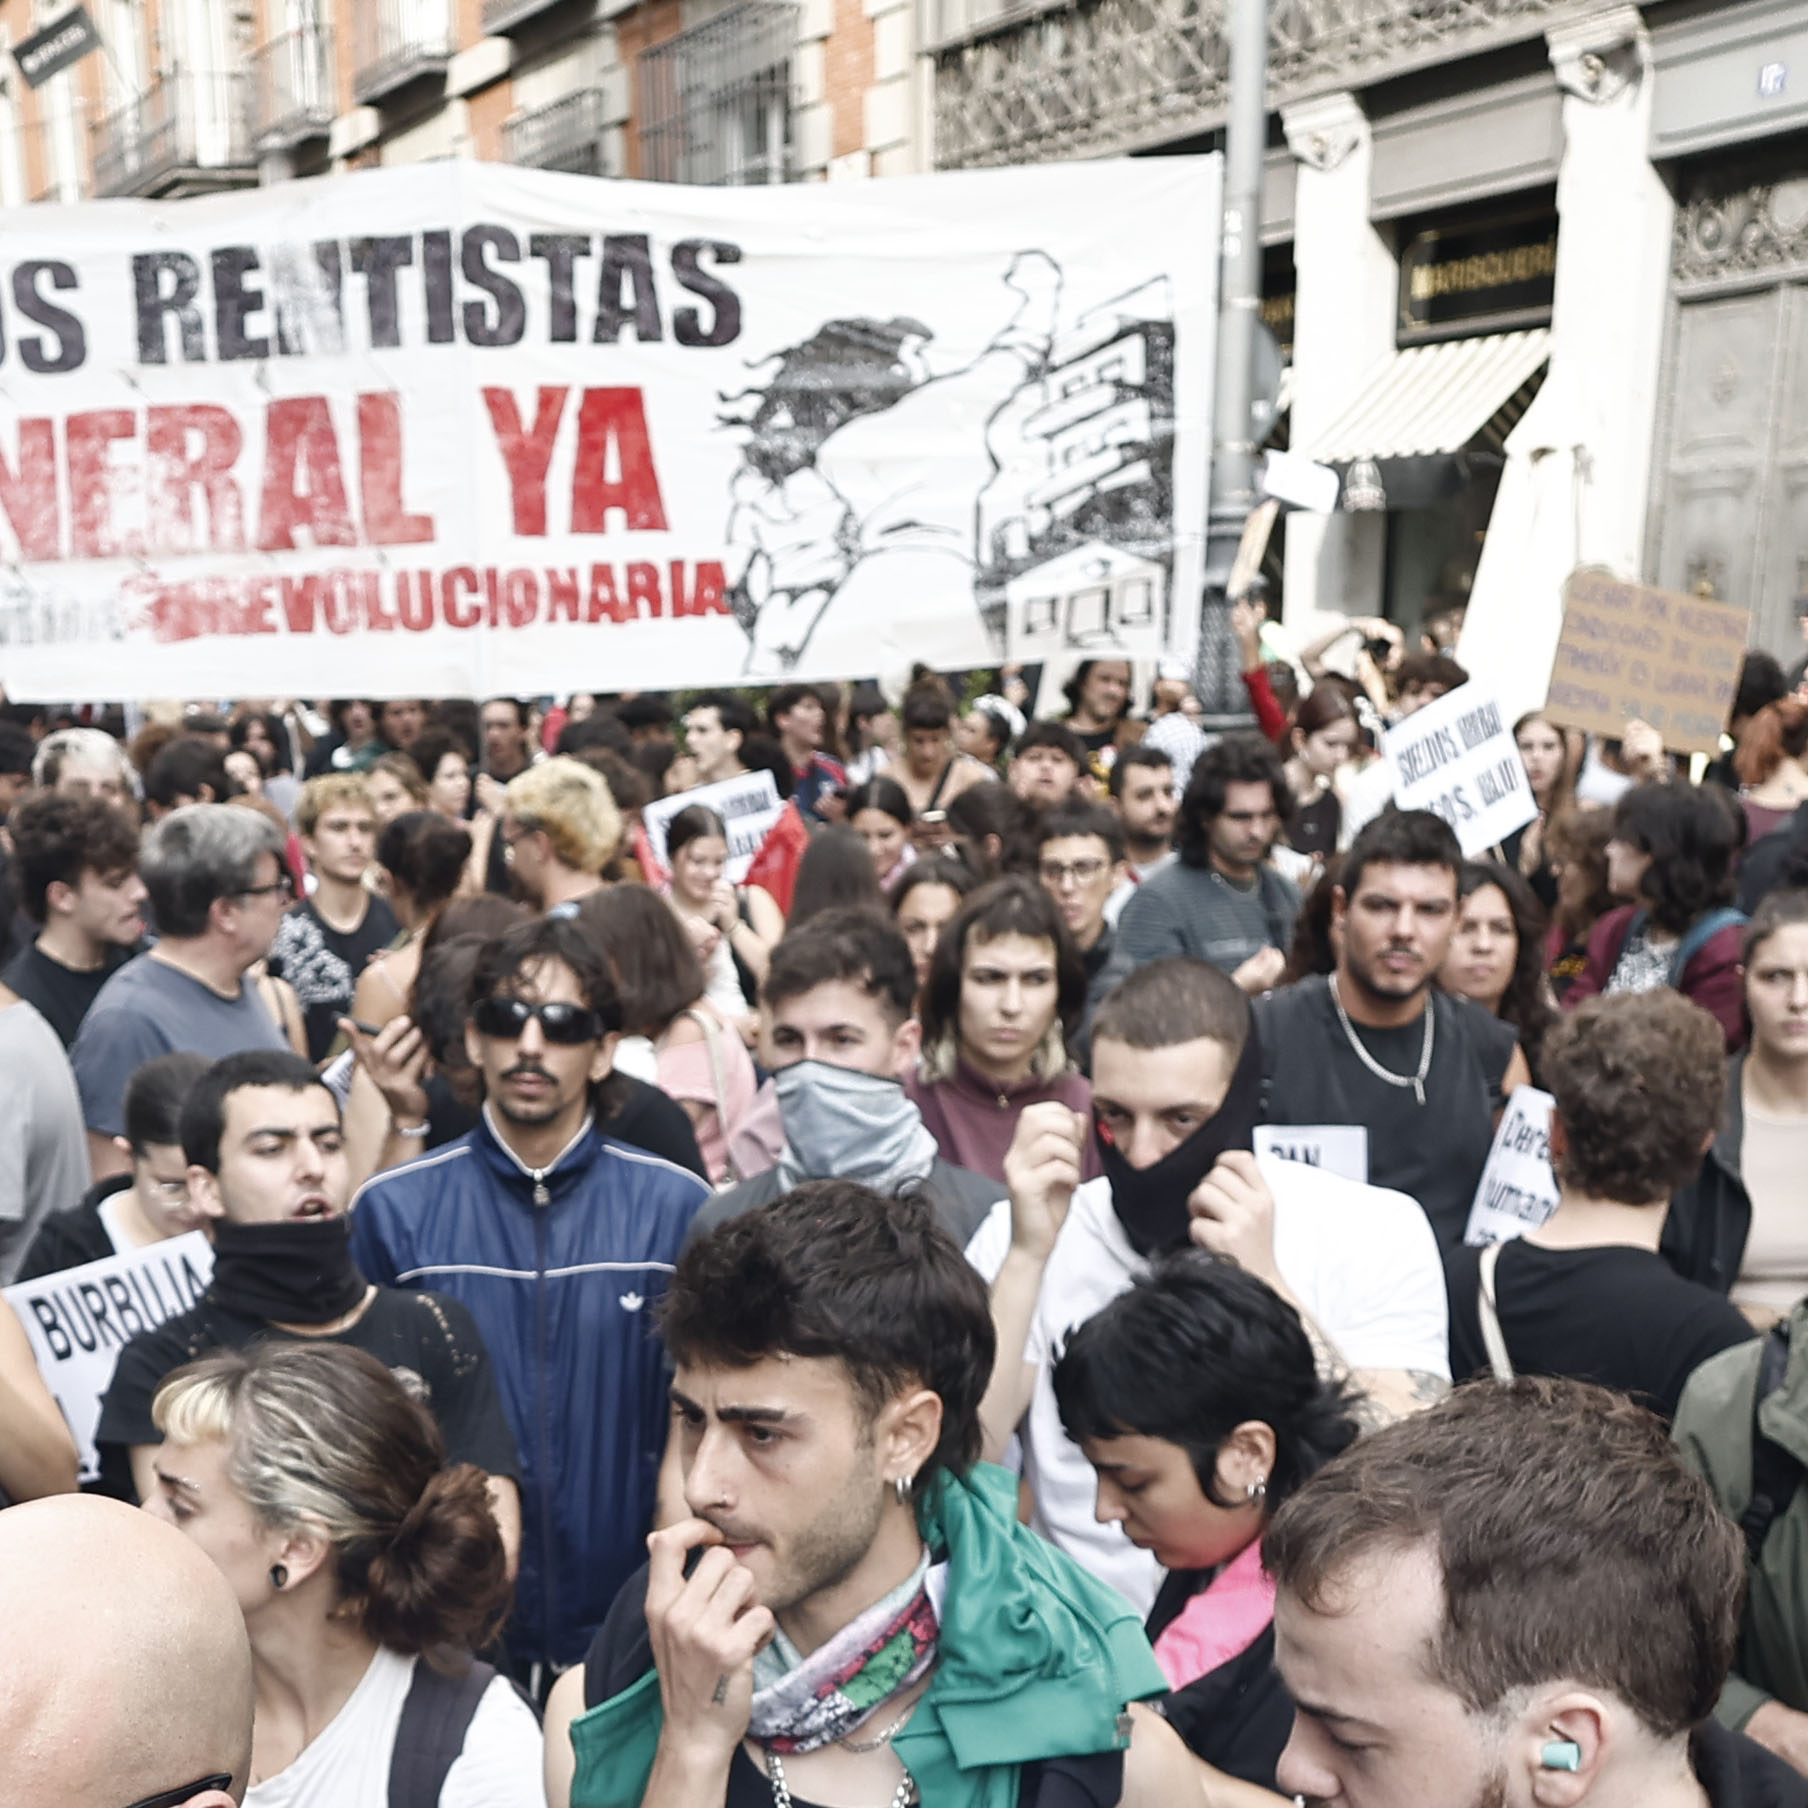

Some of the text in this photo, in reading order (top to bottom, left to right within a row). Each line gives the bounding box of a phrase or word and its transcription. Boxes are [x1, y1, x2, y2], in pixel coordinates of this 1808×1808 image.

[131, 222, 744, 365] RENTISTAS
[480, 384, 672, 538] YA
[28, 1252, 206, 1362] BURBUJA
